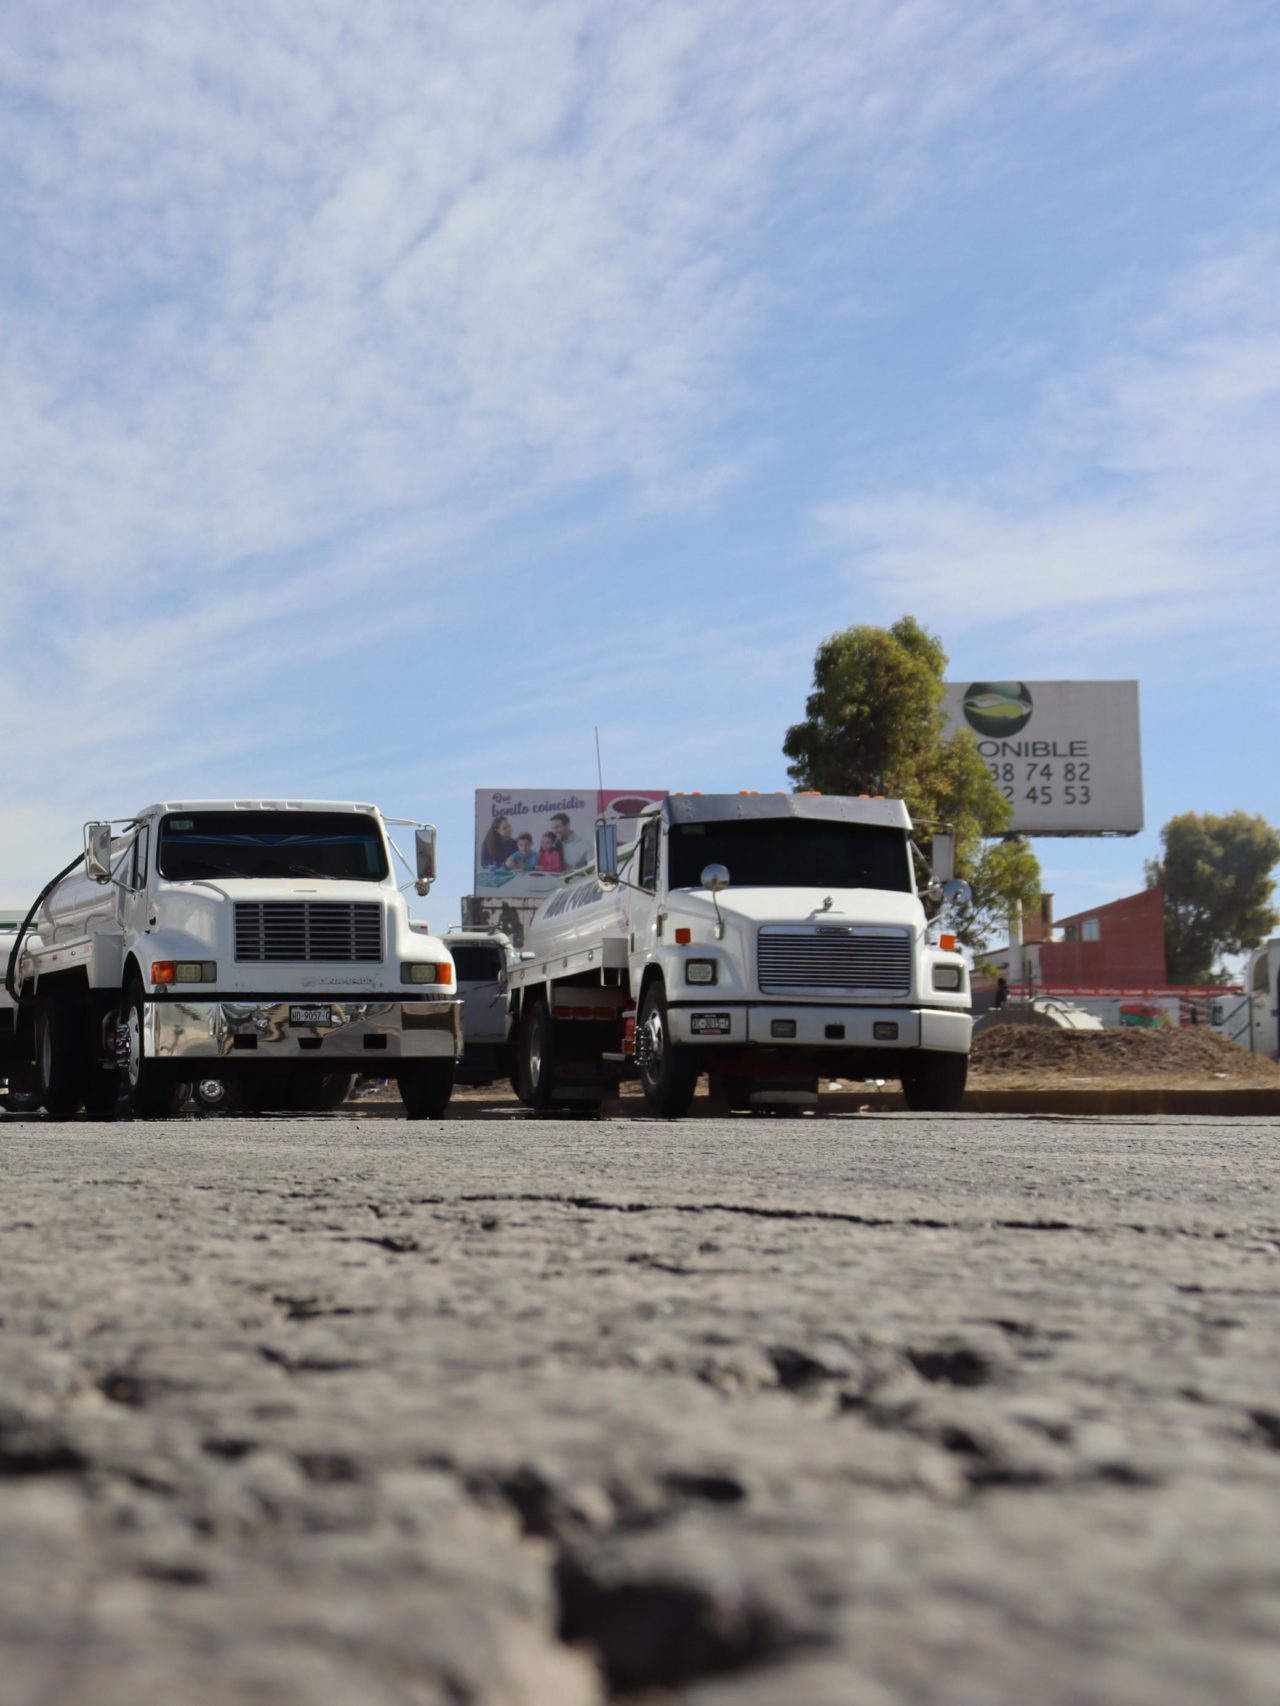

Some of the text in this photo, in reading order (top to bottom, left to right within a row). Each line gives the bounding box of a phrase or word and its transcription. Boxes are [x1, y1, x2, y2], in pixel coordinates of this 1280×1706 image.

[977, 740, 1089, 758] ONIBLE
[1026, 762, 1054, 782] 74
[1063, 762, 1091, 782] 82
[1002, 785, 1091, 805] 2 45 53
[492, 795, 586, 818] bonito coincidir
